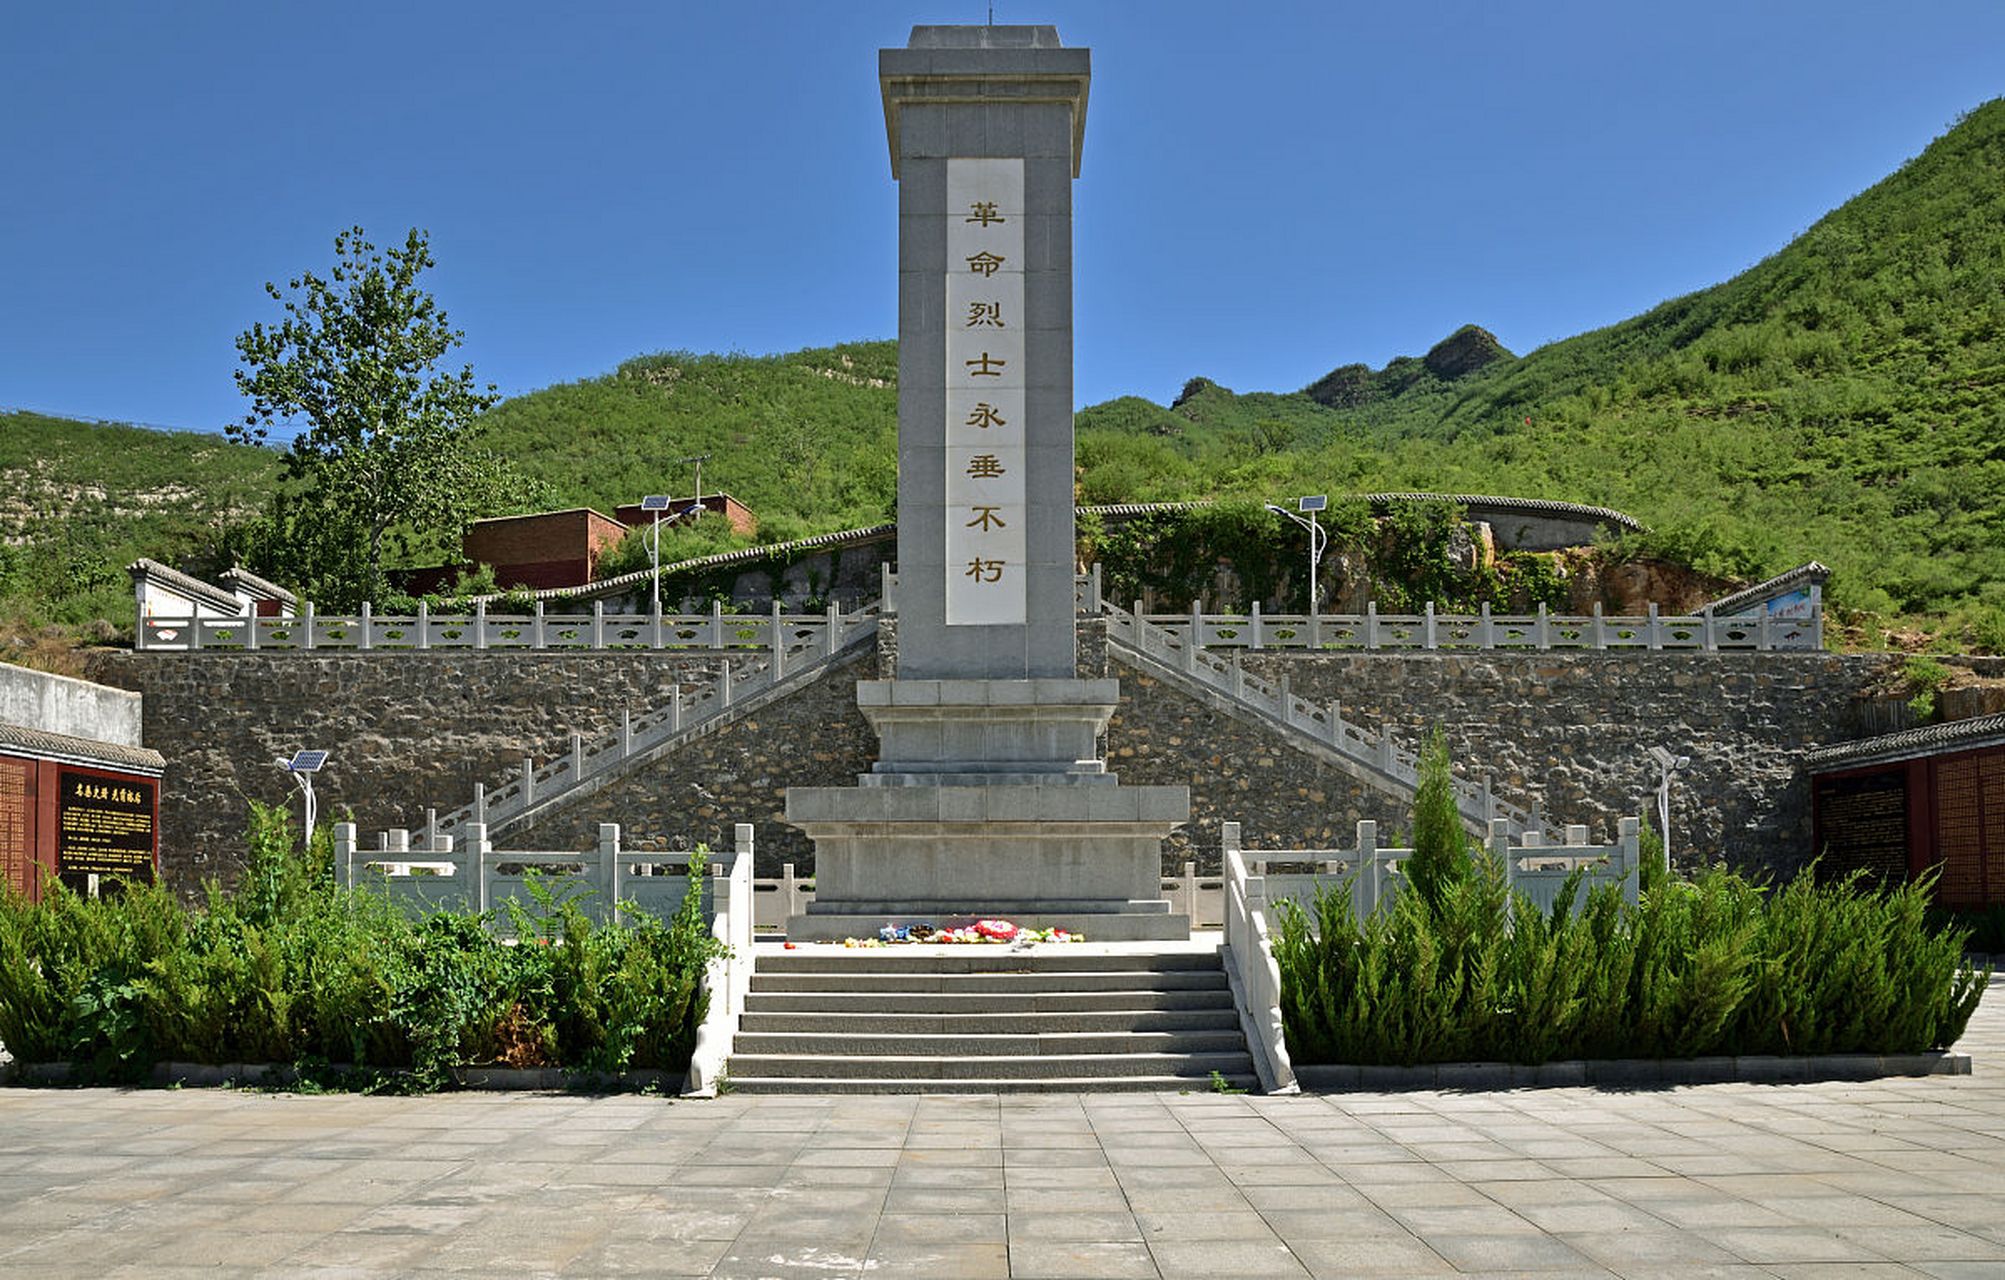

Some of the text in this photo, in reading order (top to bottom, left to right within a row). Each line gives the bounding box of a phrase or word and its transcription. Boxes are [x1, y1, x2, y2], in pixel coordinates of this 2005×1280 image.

[965, 201, 1006, 584] 革命烈士永垂不朽
